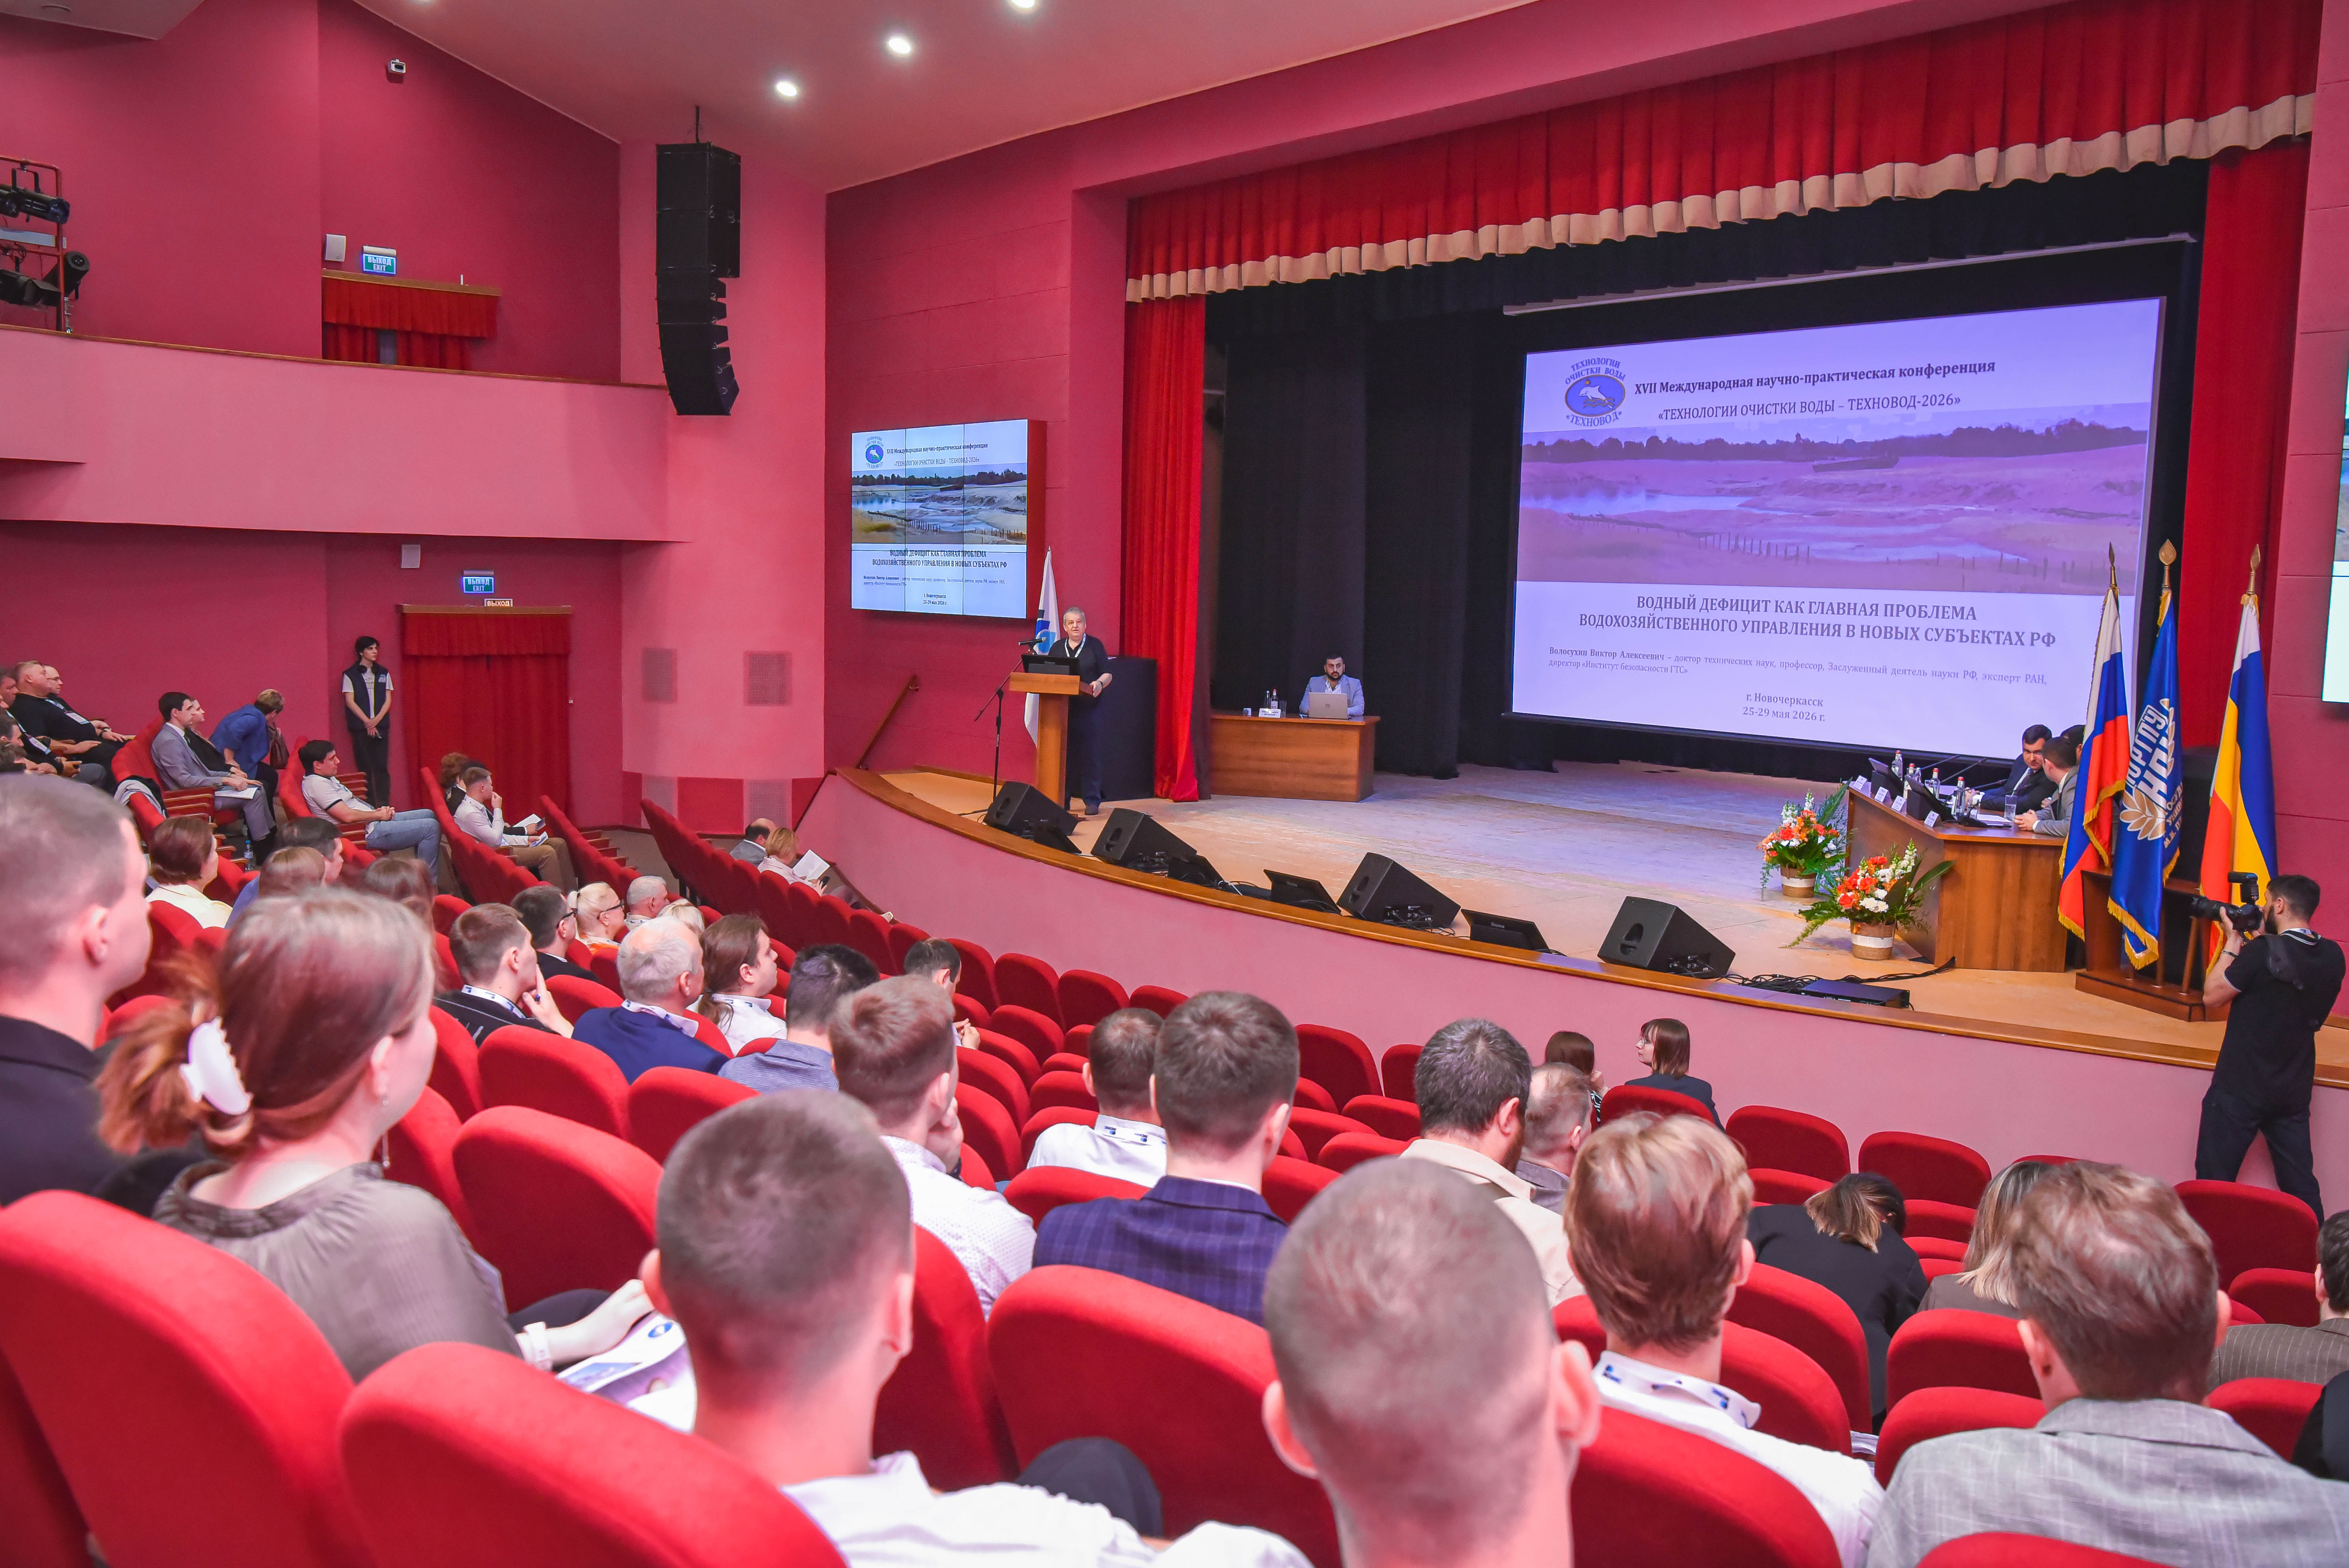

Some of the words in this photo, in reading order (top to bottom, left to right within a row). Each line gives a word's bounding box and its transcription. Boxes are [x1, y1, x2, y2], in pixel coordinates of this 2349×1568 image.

[368, 256, 391, 266] ВЫХОД
[1571, 358, 1621, 371] ТЕХНОЛОГИИ
[1565, 367, 1601, 385] ОЧИСТКИ
[1605, 367, 1626, 381] ВОДЫ
[1635, 383, 1656, 394] XVII
[1660, 377, 1753, 393] Международная
[1756, 369, 1895, 388] научно-практическая
[1899, 362, 1996, 379] конференция
[1658, 405, 1737, 420] «ТЕХНОЛОГИИ
[1740, 402, 1796, 416] ОЧИСТКИ
[1800, 400, 1835, 414] ВОДЫ
[1848, 394, 1961, 410] ТЕХНОВОД-2026»
[1566, 411, 1622, 426] «ТЕХНОВОД»
[1637, 594, 1696, 610] ВОДНЫЙ
[1699, 597, 1770, 614] ДЕФИЦИТ
[1774, 600, 1804, 614] КАК
[1809, 601, 1879, 616] ГЛАВНАЯ
[1884, 604, 1977, 620] ПРОБЛЕМА
[1579, 614, 1737, 632] ВОДОХОЗЯЙСТВЕННОГО
[1741, 620, 1841, 637] УПРАВЛЕНИЯ
[1846, 625, 1855, 637] В
[1860, 625, 1920, 641] НОВЫХ
[1924, 627, 2024, 646] СУБЪЕКТАХ
[2030, 632, 2056, 647] РФ
[1550, 647, 1587, 657] Волосухин
[1590, 649, 1617, 659] Виктор
[1620, 651, 1664, 660] Алексеевич
[1704, 657, 1752, 665] технических
[1756, 660, 1776, 668] наук,
[1779, 660, 1824, 671] профессор,
[1828, 662, 1887, 674] Заслуженный
[1891, 668, 1927, 676] деятель
[1932, 670, 1959, 679] науки
[1963, 670, 1978, 680] РФ,
[1982, 672, 2021, 684] эксперт
[2025, 674, 2047, 685] РАН,
[1582, 661, 1619, 671] «Институт
[1621, 663, 1668, 673] безопасности
[1754, 693, 1824, 707] Новочеркасск
[1743, 707, 1769, 717] 25-29
[1793, 711, 1817, 721] 2026
